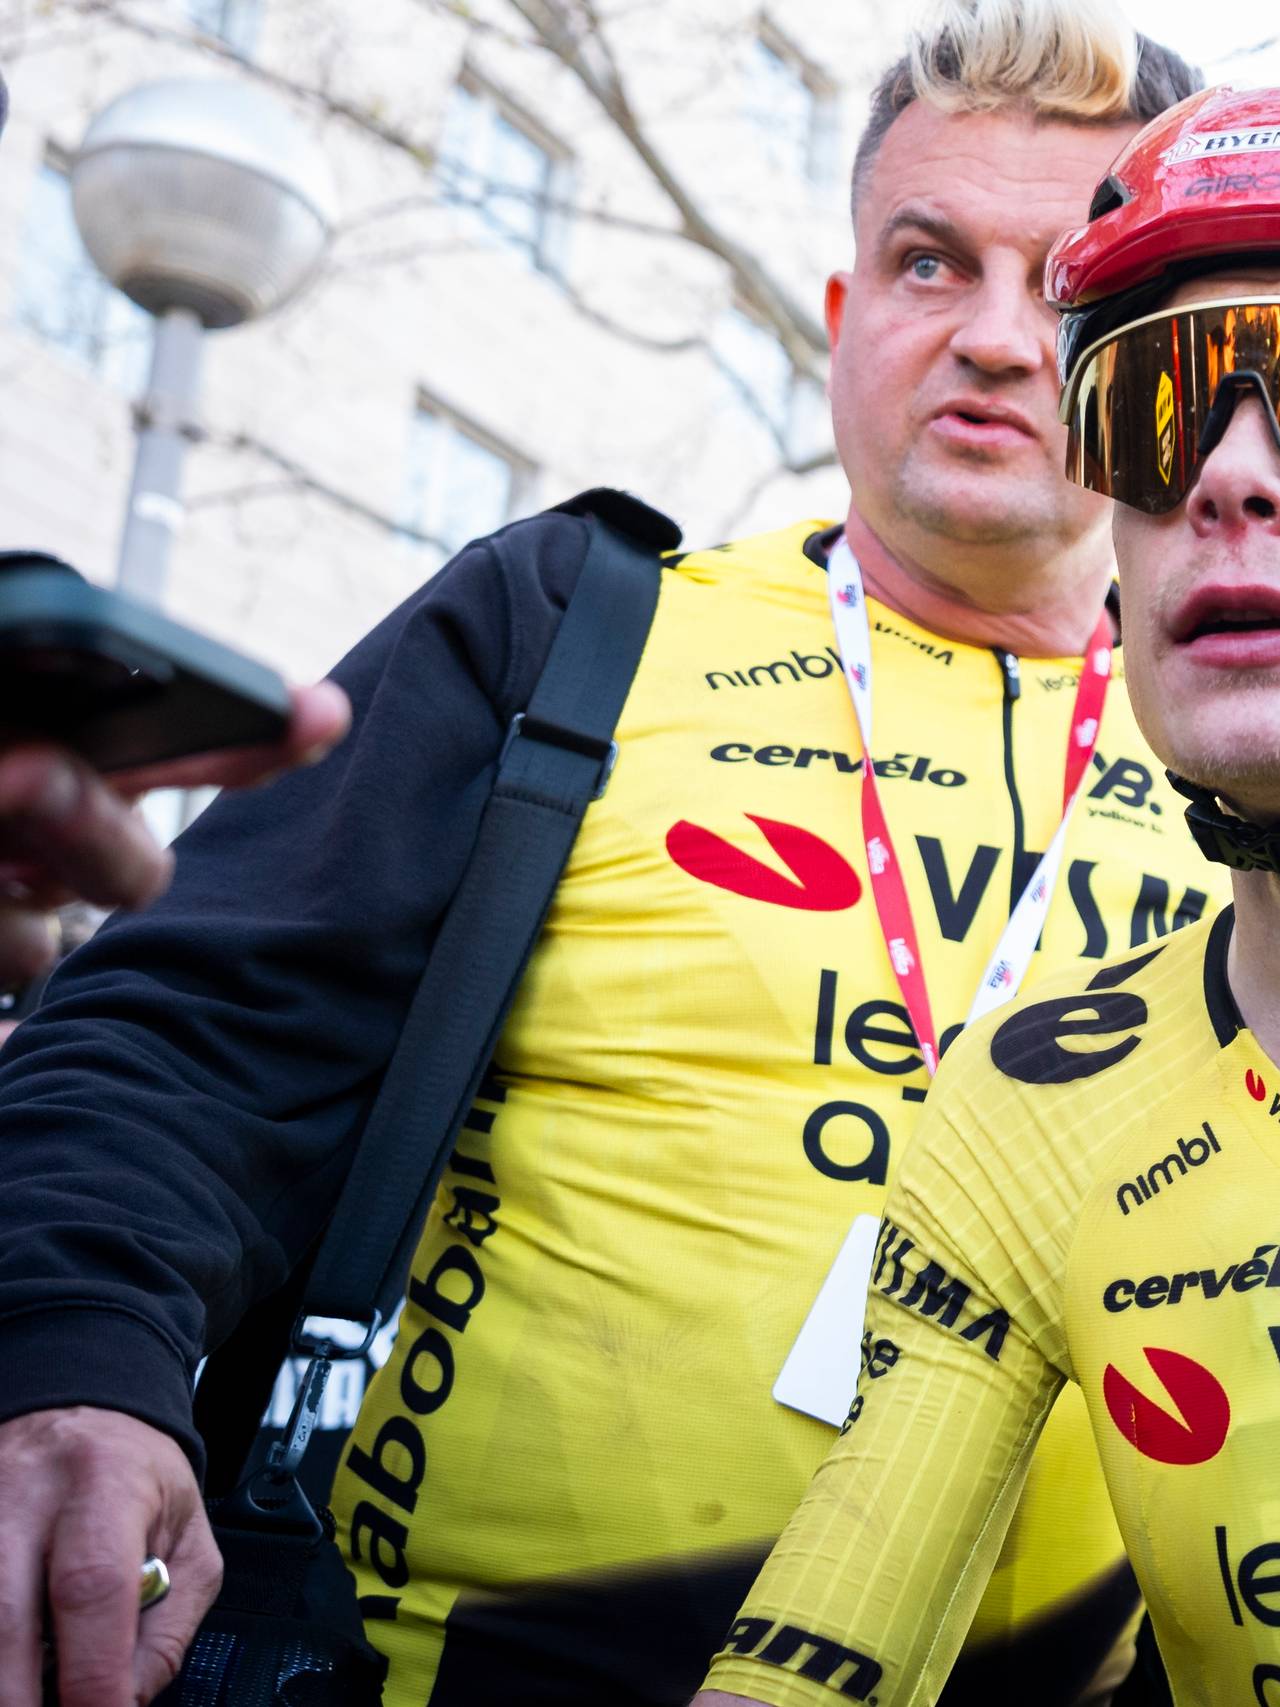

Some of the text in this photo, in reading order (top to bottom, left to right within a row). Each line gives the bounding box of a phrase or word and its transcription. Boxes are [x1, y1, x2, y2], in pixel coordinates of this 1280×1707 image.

[709, 742, 968, 788] cervélo
[914, 834, 1208, 959] VISM
[1116, 1121, 1222, 1215] nimbl
[872, 1216, 1010, 1362] ISMA
